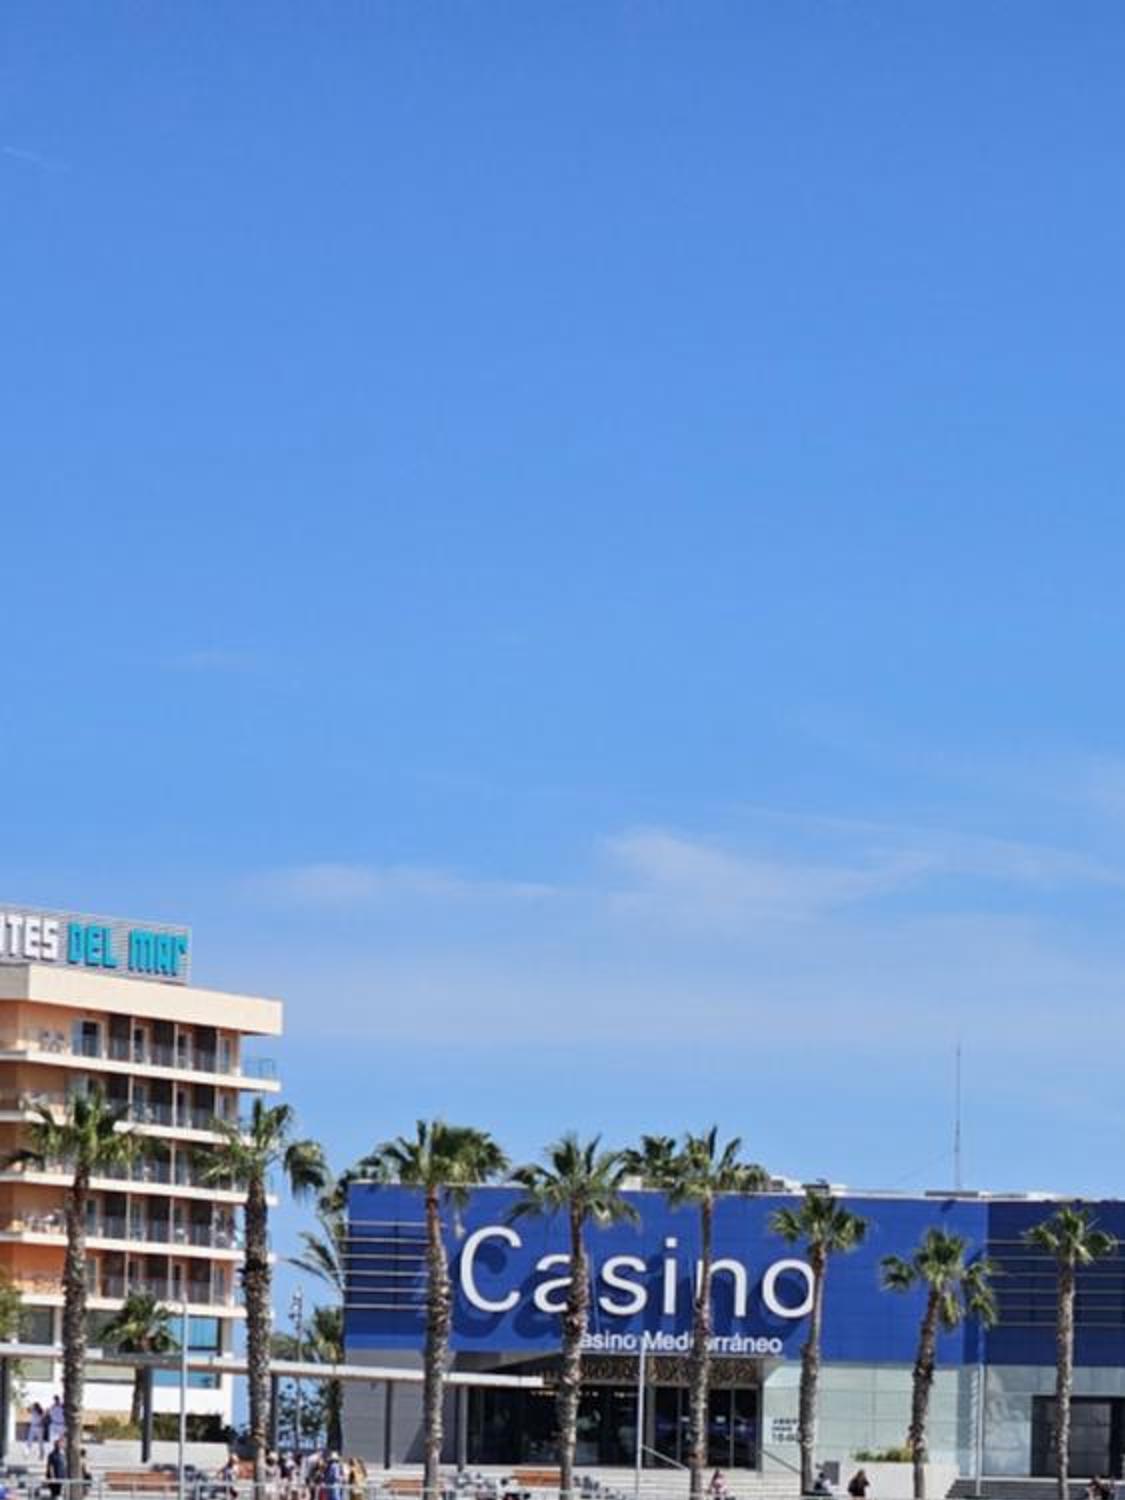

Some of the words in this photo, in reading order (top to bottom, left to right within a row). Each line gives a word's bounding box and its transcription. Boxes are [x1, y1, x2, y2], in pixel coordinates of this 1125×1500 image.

[68, 921, 116, 968] DEL
[460, 1226, 815, 1317] Casino
[576, 1329, 637, 1350] asino
